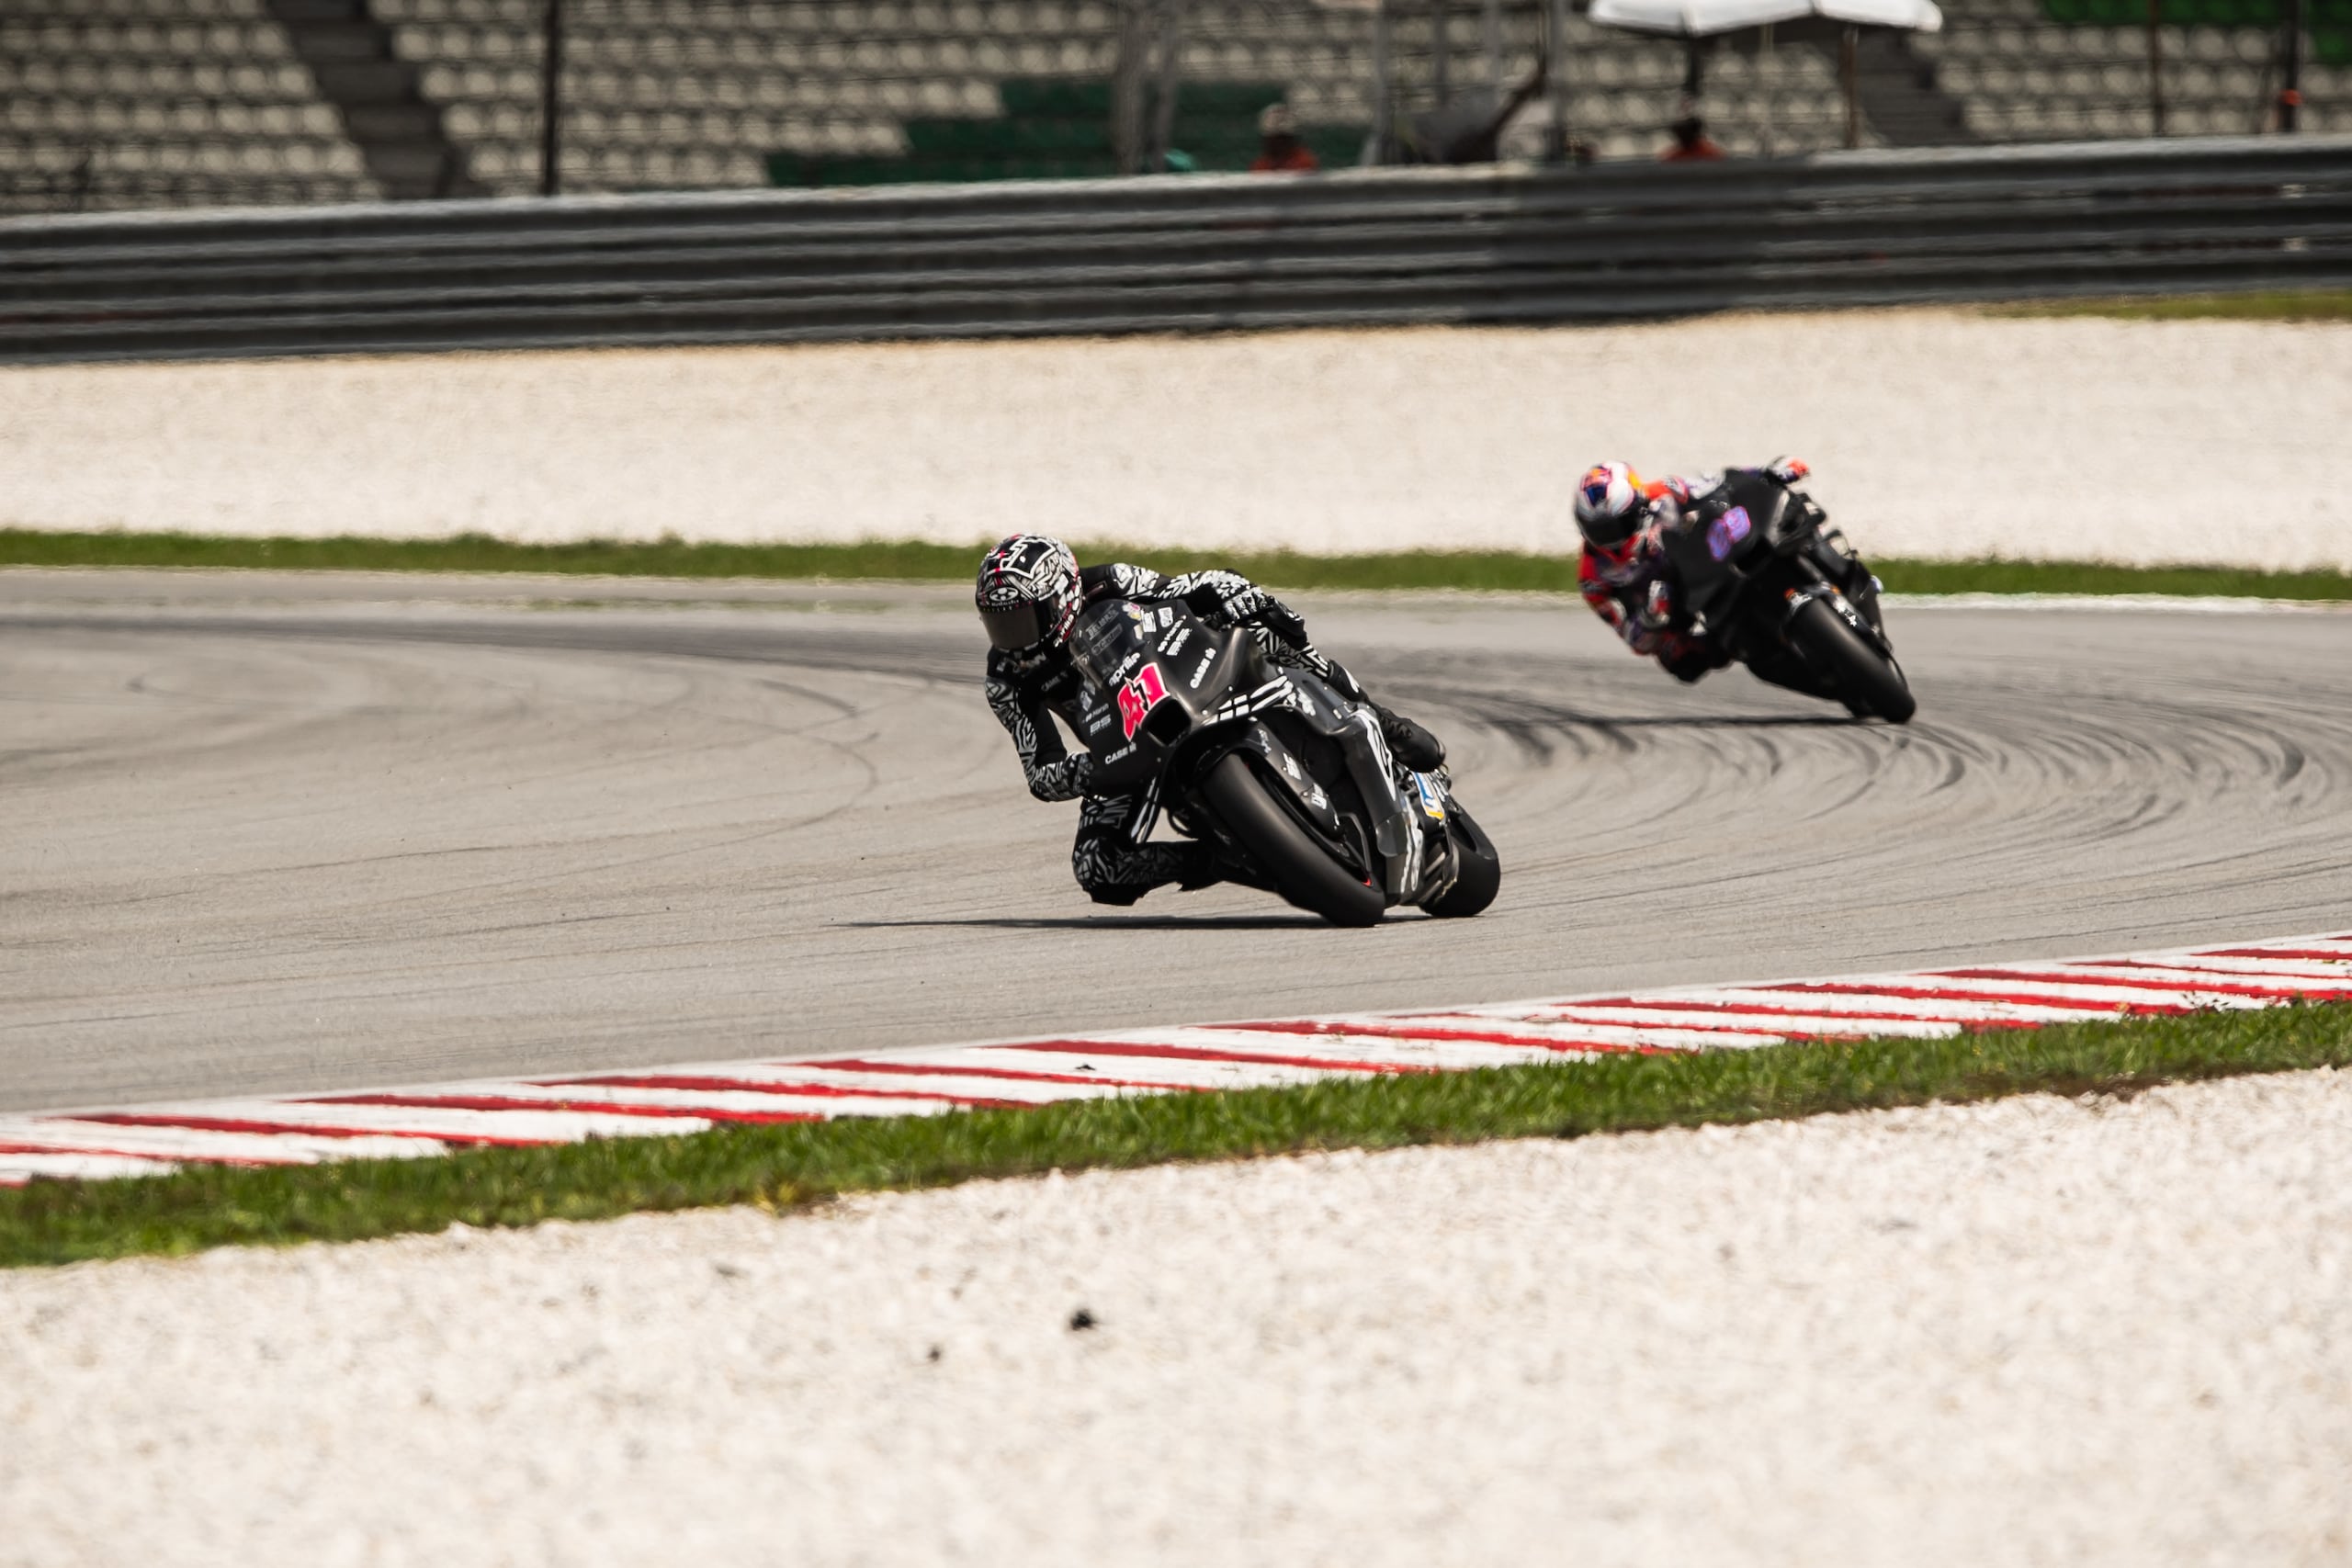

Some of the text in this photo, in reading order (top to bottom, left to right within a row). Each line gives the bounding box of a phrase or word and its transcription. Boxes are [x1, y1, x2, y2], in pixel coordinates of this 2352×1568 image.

[1108, 652, 1141, 687] aprilia
[1117, 661, 1171, 742] 41
[1105, 747, 1128, 764] CASE
